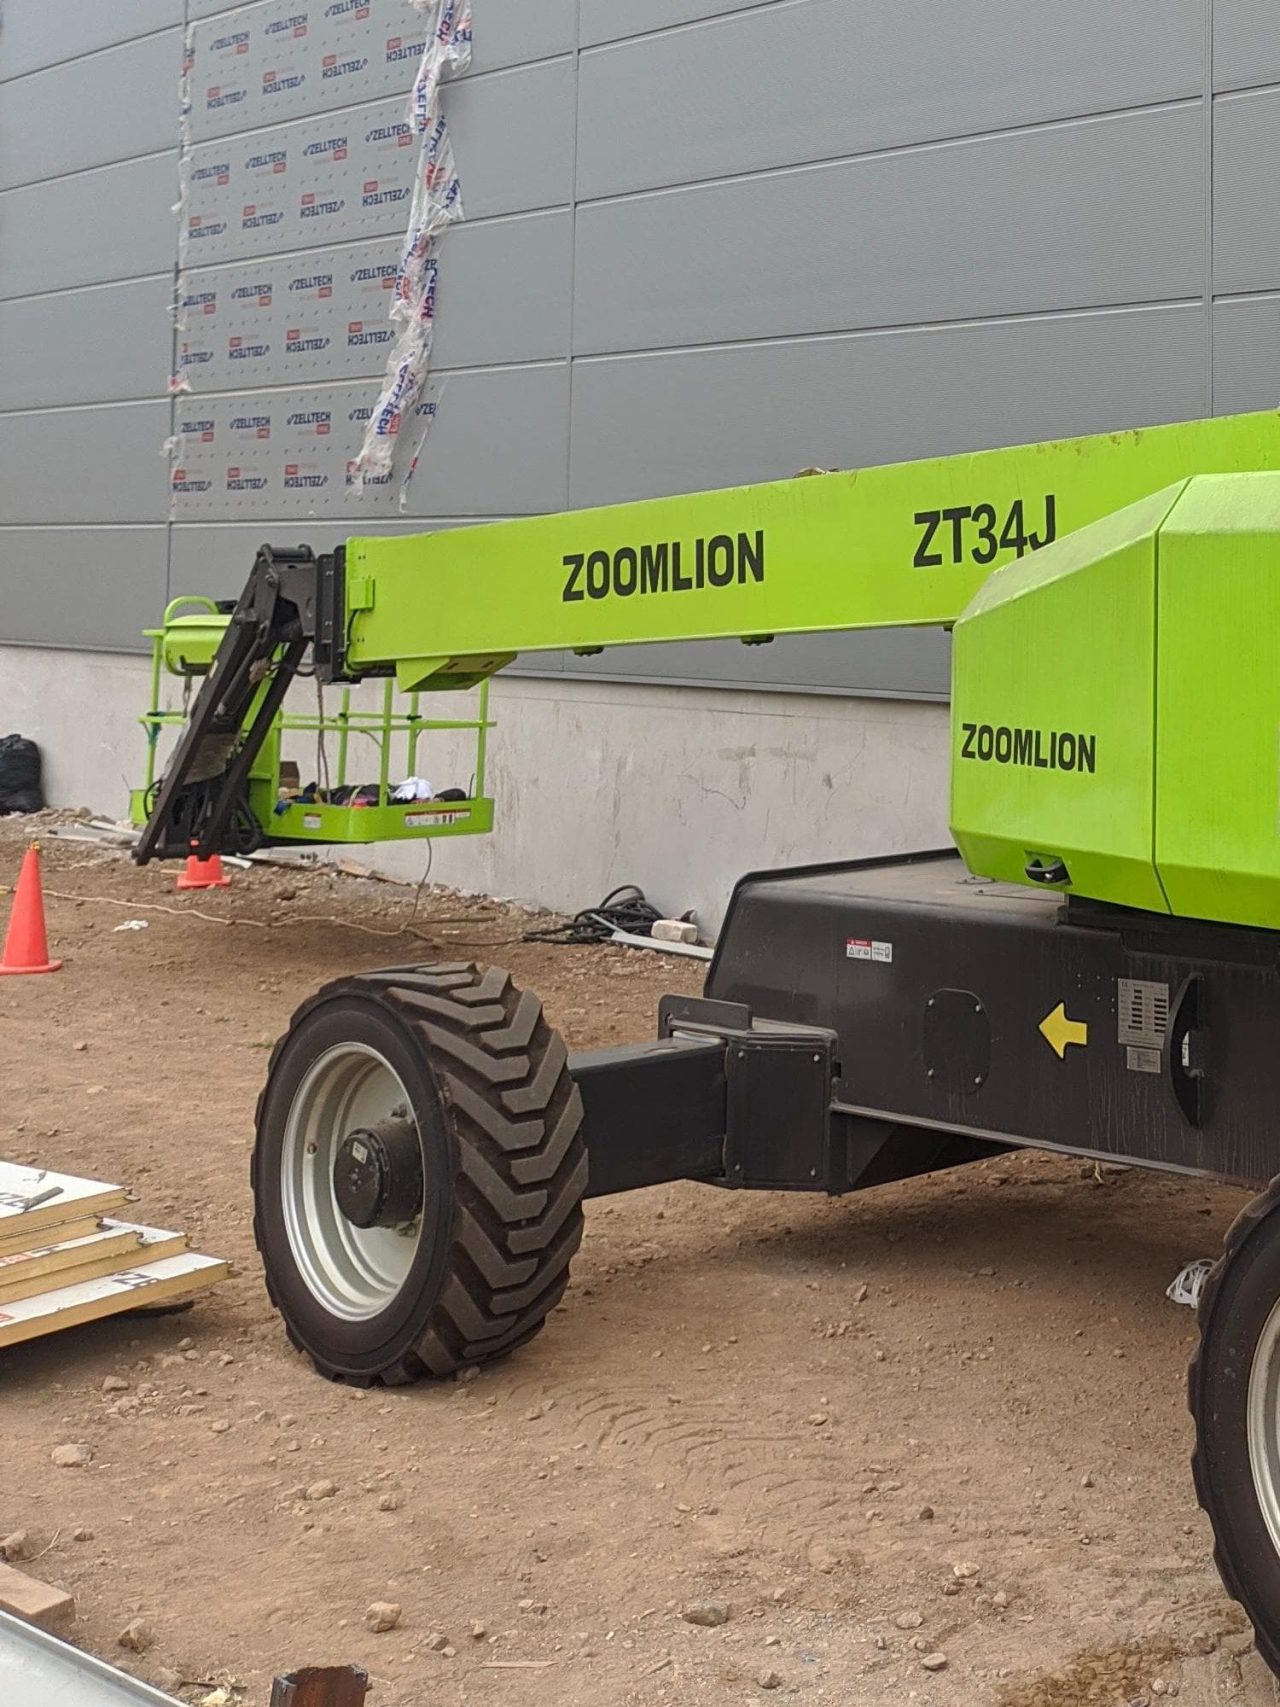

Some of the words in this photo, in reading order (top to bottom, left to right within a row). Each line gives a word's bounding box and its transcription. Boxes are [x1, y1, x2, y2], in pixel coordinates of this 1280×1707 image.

[271, 14, 308, 34] ZELLTECH
[323, 60, 361, 78] ZELLTECH
[263, 76, 300, 95] ZELLTECH
[309, 137, 347, 155] ZELLTECH
[251, 151, 286, 169] ZELLTECH
[363, 189, 402, 207] ZELLTECH
[301, 201, 340, 218] ZELLTECH
[243, 211, 278, 228] ZELLTECH
[356, 264, 398, 282] ZELLTECH
[296, 274, 332, 291] ZELLTECH
[237, 284, 272, 299] ZELLTECH
[286, 338, 321, 353] ZELLTECH
[348, 331, 388, 346] ZELLTECH
[229, 345, 265, 360] ZELLTECH
[235, 416, 271, 430] ZELLTECH
[294, 411, 331, 425] ZELLTECH
[227, 478, 262, 490] ZELLTECH
[284, 475, 323, 488] ZELLTECH
[913, 494, 1056, 568] ZT34J
[562, 530, 764, 602] ZOOMLION
[962, 723, 1096, 773] ZOOMLION
